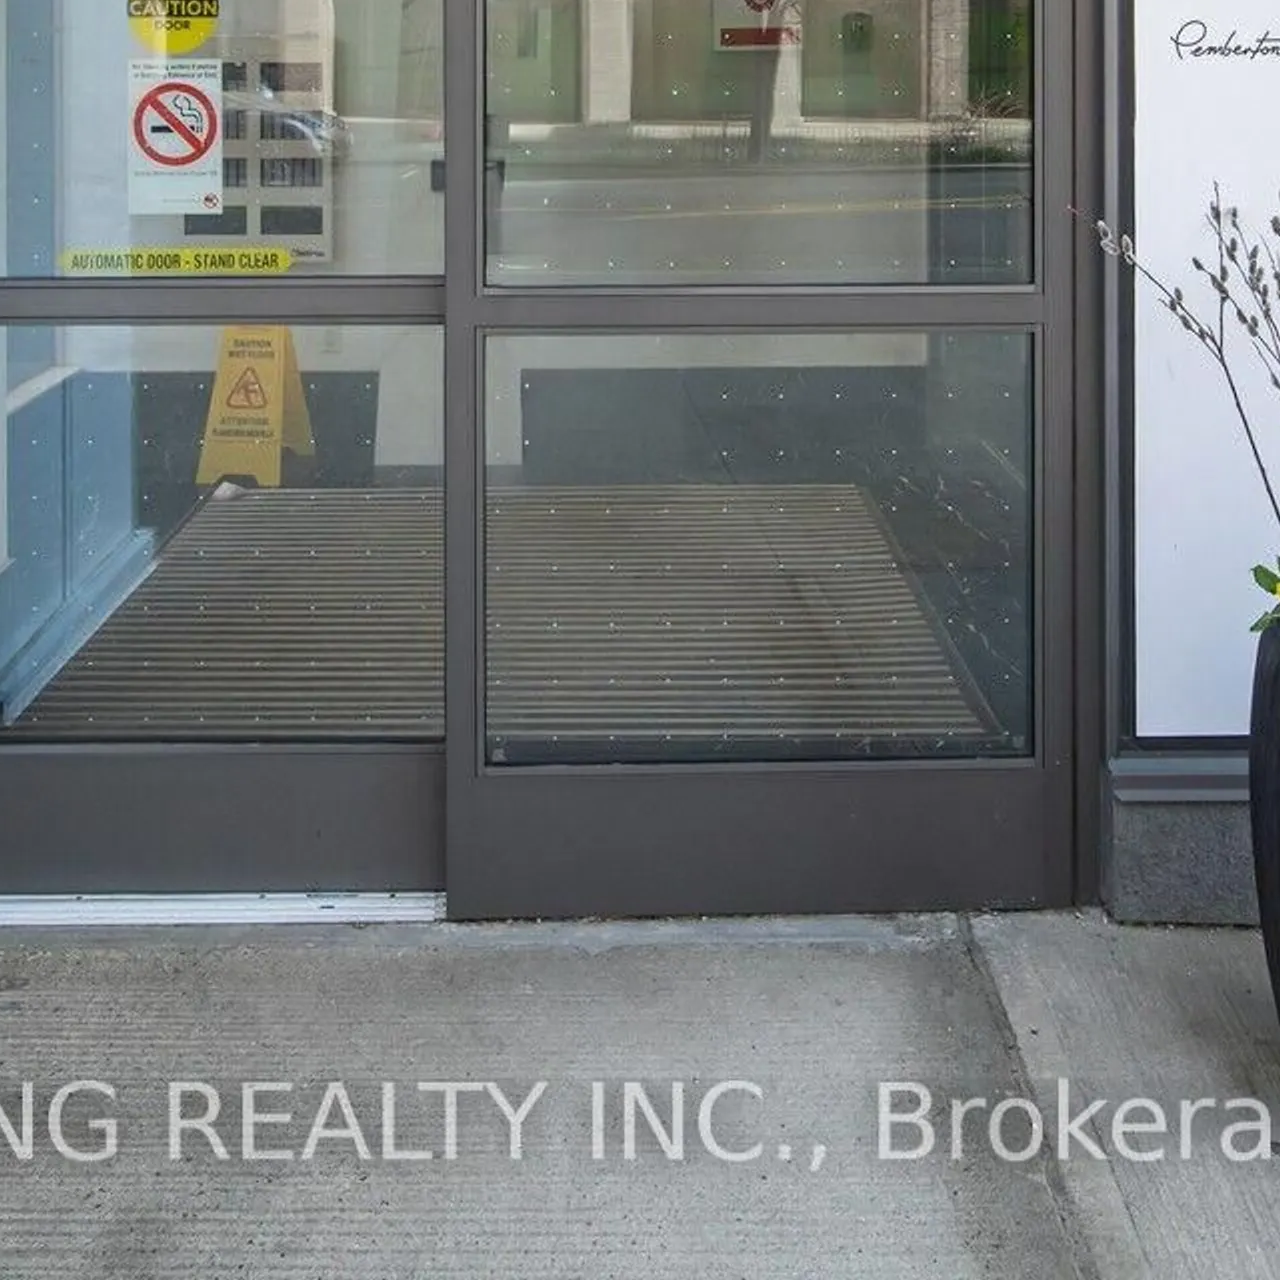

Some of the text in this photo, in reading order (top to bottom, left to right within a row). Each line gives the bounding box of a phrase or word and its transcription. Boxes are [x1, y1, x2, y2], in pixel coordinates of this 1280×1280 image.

[130, 0, 217, 15] CAUTION
[155, 20, 191, 30] DOOR
[72, 254, 143, 269] AUTOMATIC
[147, 254, 181, 268] DOOR
[195, 254, 235, 268] STAND
[241, 254, 279, 267] CLEAR
